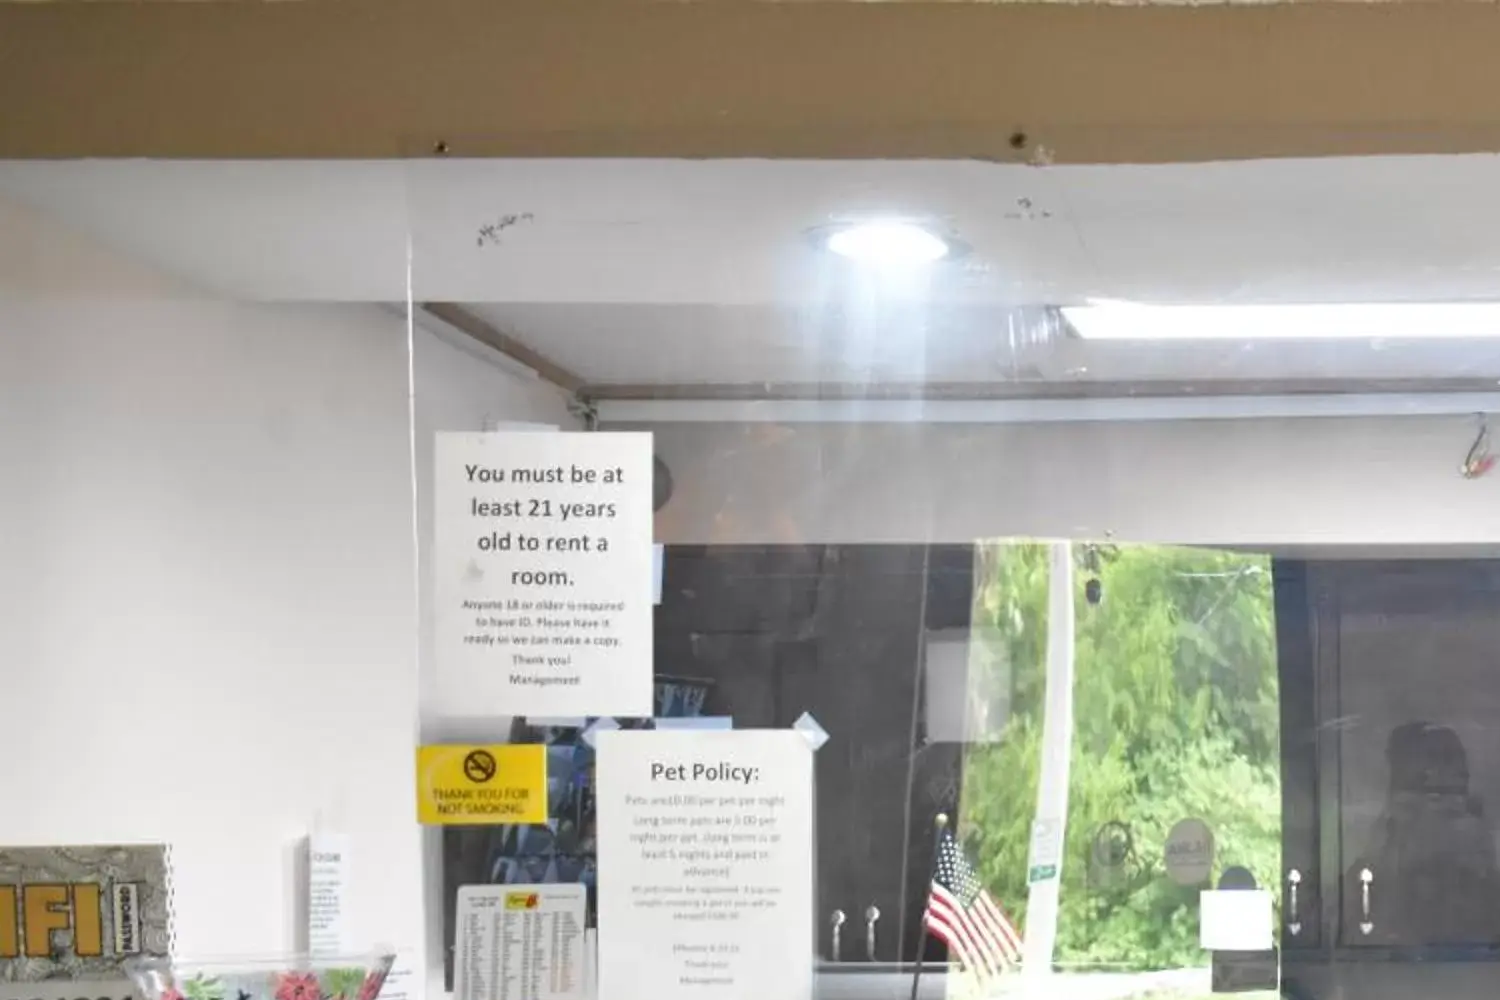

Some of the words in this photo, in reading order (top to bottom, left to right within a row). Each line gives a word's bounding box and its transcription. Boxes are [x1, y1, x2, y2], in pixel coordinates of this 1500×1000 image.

[465, 464, 505, 483] You
[511, 466, 564, 483] must
[571, 464, 597, 483] be
[602, 466, 624, 483] at
[471, 496, 521, 517] least
[528, 499, 553, 517] 21
[559, 502, 616, 521] years
[477, 531, 511, 551] old
[517, 534, 540, 551] to
[546, 535, 590, 551] rent
[596, 537, 609, 551] a
[511, 570, 575, 586] room.
[476, 617, 488, 627] to
[489, 616, 516, 627] have
[536, 616, 571, 627] Please
[573, 617, 599, 627] have
[511, 636, 529, 645] we
[551, 635, 581, 645] make
[512, 654, 545, 665] Thank
[508, 673, 581, 686] Management
[650, 763, 687, 781] Pet
[693, 761, 760, 784] Policy:
[432, 787, 474, 800] THANK
[478, 787, 503, 800] YOU
[437, 803, 464, 815] NOT
[0, 883, 103, 957] IFI
